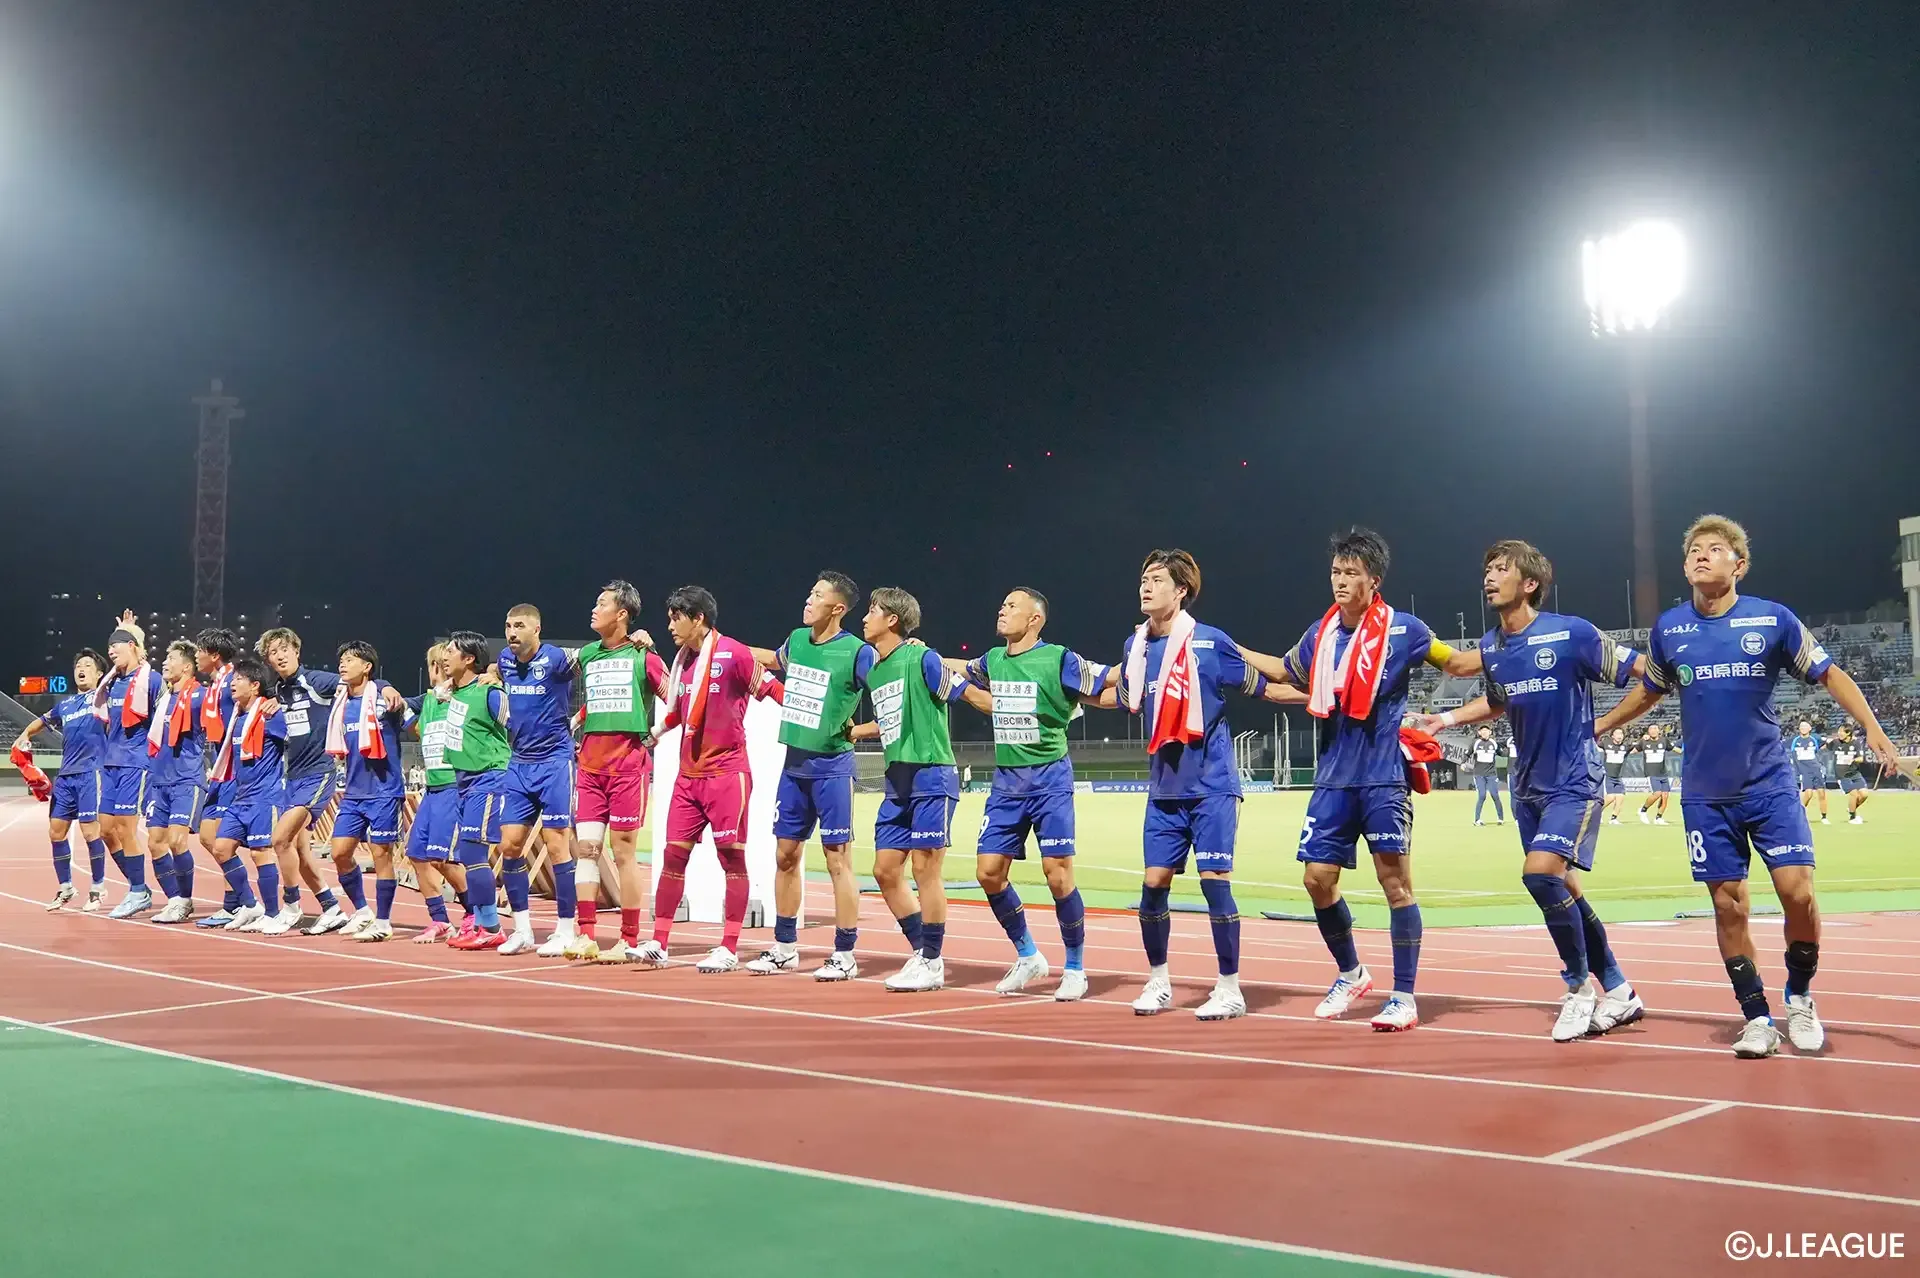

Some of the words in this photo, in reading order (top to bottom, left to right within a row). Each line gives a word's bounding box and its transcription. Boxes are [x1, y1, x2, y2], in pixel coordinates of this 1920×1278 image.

[1695, 663, 1766, 680] 西原商会
[510, 685, 546, 695] 西原商会
[596, 688, 627, 696] MBC開発
[1504, 676, 1558, 696] 西原商会
[998, 717, 1032, 726] MBC開発
[1300, 816, 1316, 844] 5
